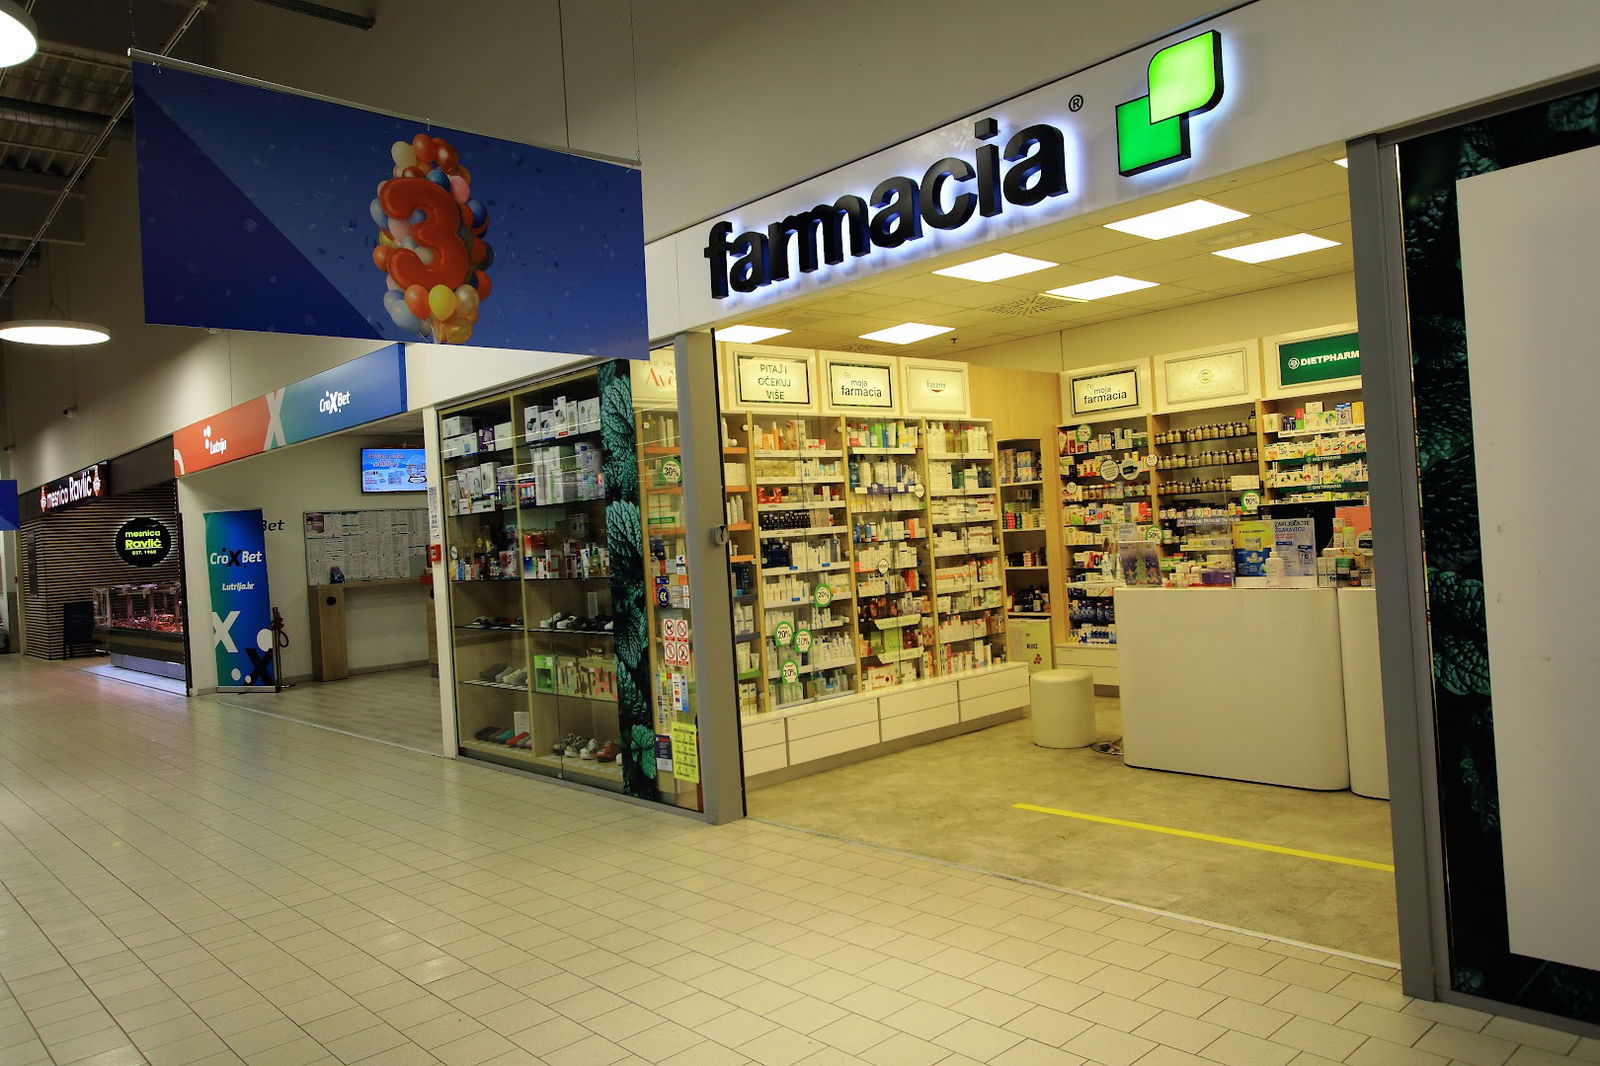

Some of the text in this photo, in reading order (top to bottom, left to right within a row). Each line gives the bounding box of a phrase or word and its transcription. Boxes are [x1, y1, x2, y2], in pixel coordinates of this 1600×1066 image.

[704, 117, 1068, 299] farmacia
[1300, 350, 1360, 366] DIETPHARM
[760, 364, 783, 375] PITAJ
[757, 375, 791, 388] OČEKUJ
[850, 378, 868, 388] moja
[767, 389, 785, 400] VIŠE
[841, 385, 882, 398] farmacia
[1094, 385, 1112, 395] moja
[1083, 390, 1127, 405] farmacia
[69, 469, 92, 502] Ravlić
[125, 538, 161, 549] Ravlić
[210, 548, 262, 567] CroXBet
[222, 581, 254, 592] Lutrija.hr
